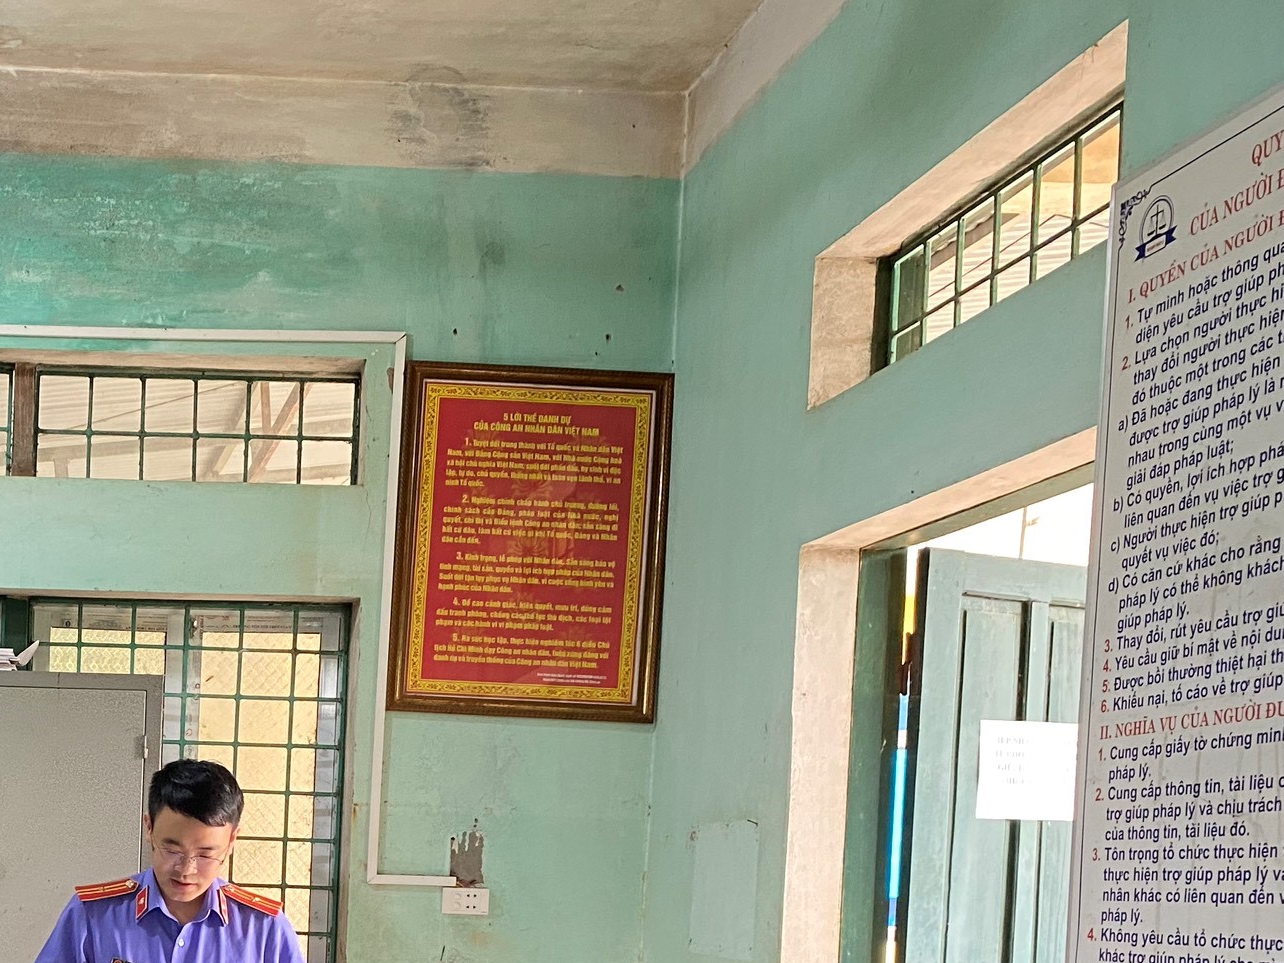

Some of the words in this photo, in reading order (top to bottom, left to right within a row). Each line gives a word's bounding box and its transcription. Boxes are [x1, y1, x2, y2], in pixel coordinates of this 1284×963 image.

[1190, 202, 1219, 235] CỦA
[1222, 171, 1273, 219] NGƯỜI
[1128, 288, 1136, 303] I.
[1139, 259, 1187, 298] QUYỀN
[1190, 243, 1219, 271] CỦA
[1222, 214, 1274, 255] NGƯỜI
[1125, 314, 1133, 330] 1.
[1137, 306, 1153, 323] Tự
[1155, 289, 1184, 315] mình
[1187, 274, 1218, 299] hoặc
[1221, 254, 1259, 282] thông
[1135, 324, 1159, 344] diện
[1162, 312, 1184, 336] yêu
[1187, 297, 1209, 319] cầu
[1212, 288, 1232, 308] trợ
[1235, 273, 1264, 301] giúp
[1121, 355, 1131, 371] 2.
[1134, 345, 1156, 365] Lựa
[1160, 330, 1189, 353] chọn
[1193, 306, 1232, 338] người
[1235, 295, 1267, 319] thực
[1133, 364, 1158, 385] thay
[1160, 350, 1179, 373] đổi
[1182, 333, 1221, 364] người
[1224, 322, 1255, 345] thực
[473, 420, 488, 431] CỦA
[547, 424, 563, 434] DÂN
[565, 426, 580, 436] VIỆT
[582, 428, 599, 436] NAM
[503, 413, 508, 421] 5
[510, 411, 522, 422] LỜI
[1112, 495, 1123, 514] b)
[1126, 489, 1142, 507] Có
[1144, 476, 1183, 504] quyền,
[1186, 468, 1203, 492] lợi
[1205, 462, 1225, 482] ích
[1228, 455, 1255, 474] hợp
[1126, 467, 1146, 491] giải
[1149, 461, 1170, 479] đáp
[1172, 449, 1203, 476] pháp
[1206, 438, 1233, 460] luật;
[1110, 536, 1120, 554] c)
[1123, 524, 1157, 550] Người
[1160, 520, 1187, 538] thực
[1189, 509, 1215, 529] hiện
[1219, 503, 1239, 521] trợ
[1241, 493, 1270, 517] giúp
[1124, 511, 1143, 528] liên
[1146, 502, 1175, 525] quan
[1178, 490, 1200, 511] đến
[1204, 488, 1219, 505] vụ
[1222, 477, 1248, 498] việc
[1252, 470, 1273, 488] trợ
[1108, 576, 1119, 595] d)
[1122, 571, 1138, 588] Có
[1141, 566, 1162, 584] căn
[1165, 559, 1183, 577] cứ
[1185, 552, 1216, 573] khác
[1219, 546, 1245, 563] cho
[1248, 534, 1282, 556] rằng
[1121, 544, 1152, 572] quyết
[1155, 545, 1169, 561] vụ
[1172, 536, 1196, 557] việc
[1199, 528, 1219, 547] đó;
[1104, 638, 1113, 653] 3.
[1116, 634, 1143, 651] Thay
[1145, 624, 1166, 644] đổi,
[1170, 622, 1186, 639] rút
[1189, 618, 1213, 639] yêu
[1213, 609, 1238, 632] cầu
[1242, 609, 1263, 626] trợ
[1099, 725, 1111, 740] II.
[1114, 715, 1156, 738] NGHĨA
[1159, 715, 1177, 735] VỤ
[1180, 705, 1209, 729] CỦA
[1212, 698, 1262, 725] NGƯỜI
[1100, 699, 1109, 713] 6.
[1112, 690, 1144, 711] Khiếu
[1147, 689, 1168, 708] nại,
[1171, 682, 1182, 702] tố
[1185, 682, 1208, 700] cáo
[1211, 676, 1226, 696] về
[1229, 678, 1250, 696] trợ
[1253, 671, 1284, 694] giúp
[1094, 787, 1104, 801] 2.
[1107, 785, 1137, 802] Cung
[1140, 779, 1162, 801] cấp
[1165, 780, 1201, 798] thông
[1204, 778, 1224, 795] tin,
[1228, 775, 1245, 792] tài
[1249, 773, 1274, 797] liệu
[1092, 847, 1100, 861] 3.
[1104, 846, 1125, 861] Tôn
[1128, 846, 1159, 864] trọng
[1162, 841, 1174, 860] tổ
[1178, 843, 1210, 861] chức
[1213, 843, 1244, 863] thực
[1248, 842, 1277, 862] hiện
[1086, 927, 1096, 941] 4.
[1100, 927, 1138, 947] Không
[1141, 929, 1163, 952] yêu
[1166, 927, 1189, 946] cầu
[1193, 928, 1206, 947] tổ
[1210, 932, 1246, 949] chức
